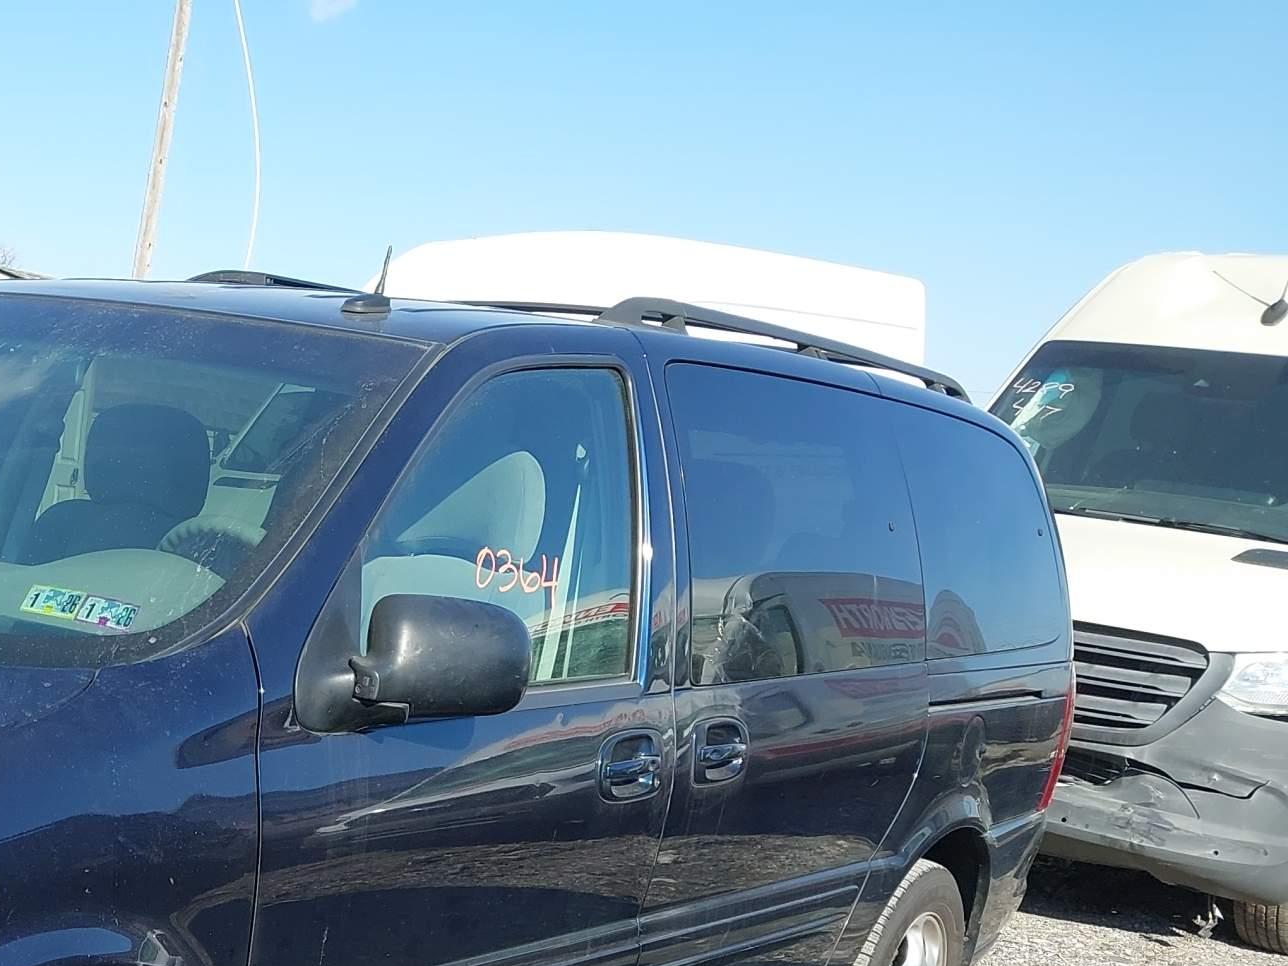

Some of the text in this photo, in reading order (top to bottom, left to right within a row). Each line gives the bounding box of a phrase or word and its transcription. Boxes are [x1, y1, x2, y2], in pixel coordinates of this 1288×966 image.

[475, 546, 559, 611] 0364
[61, 594, 81, 614] 26
[116, 606, 137, 628] 26
